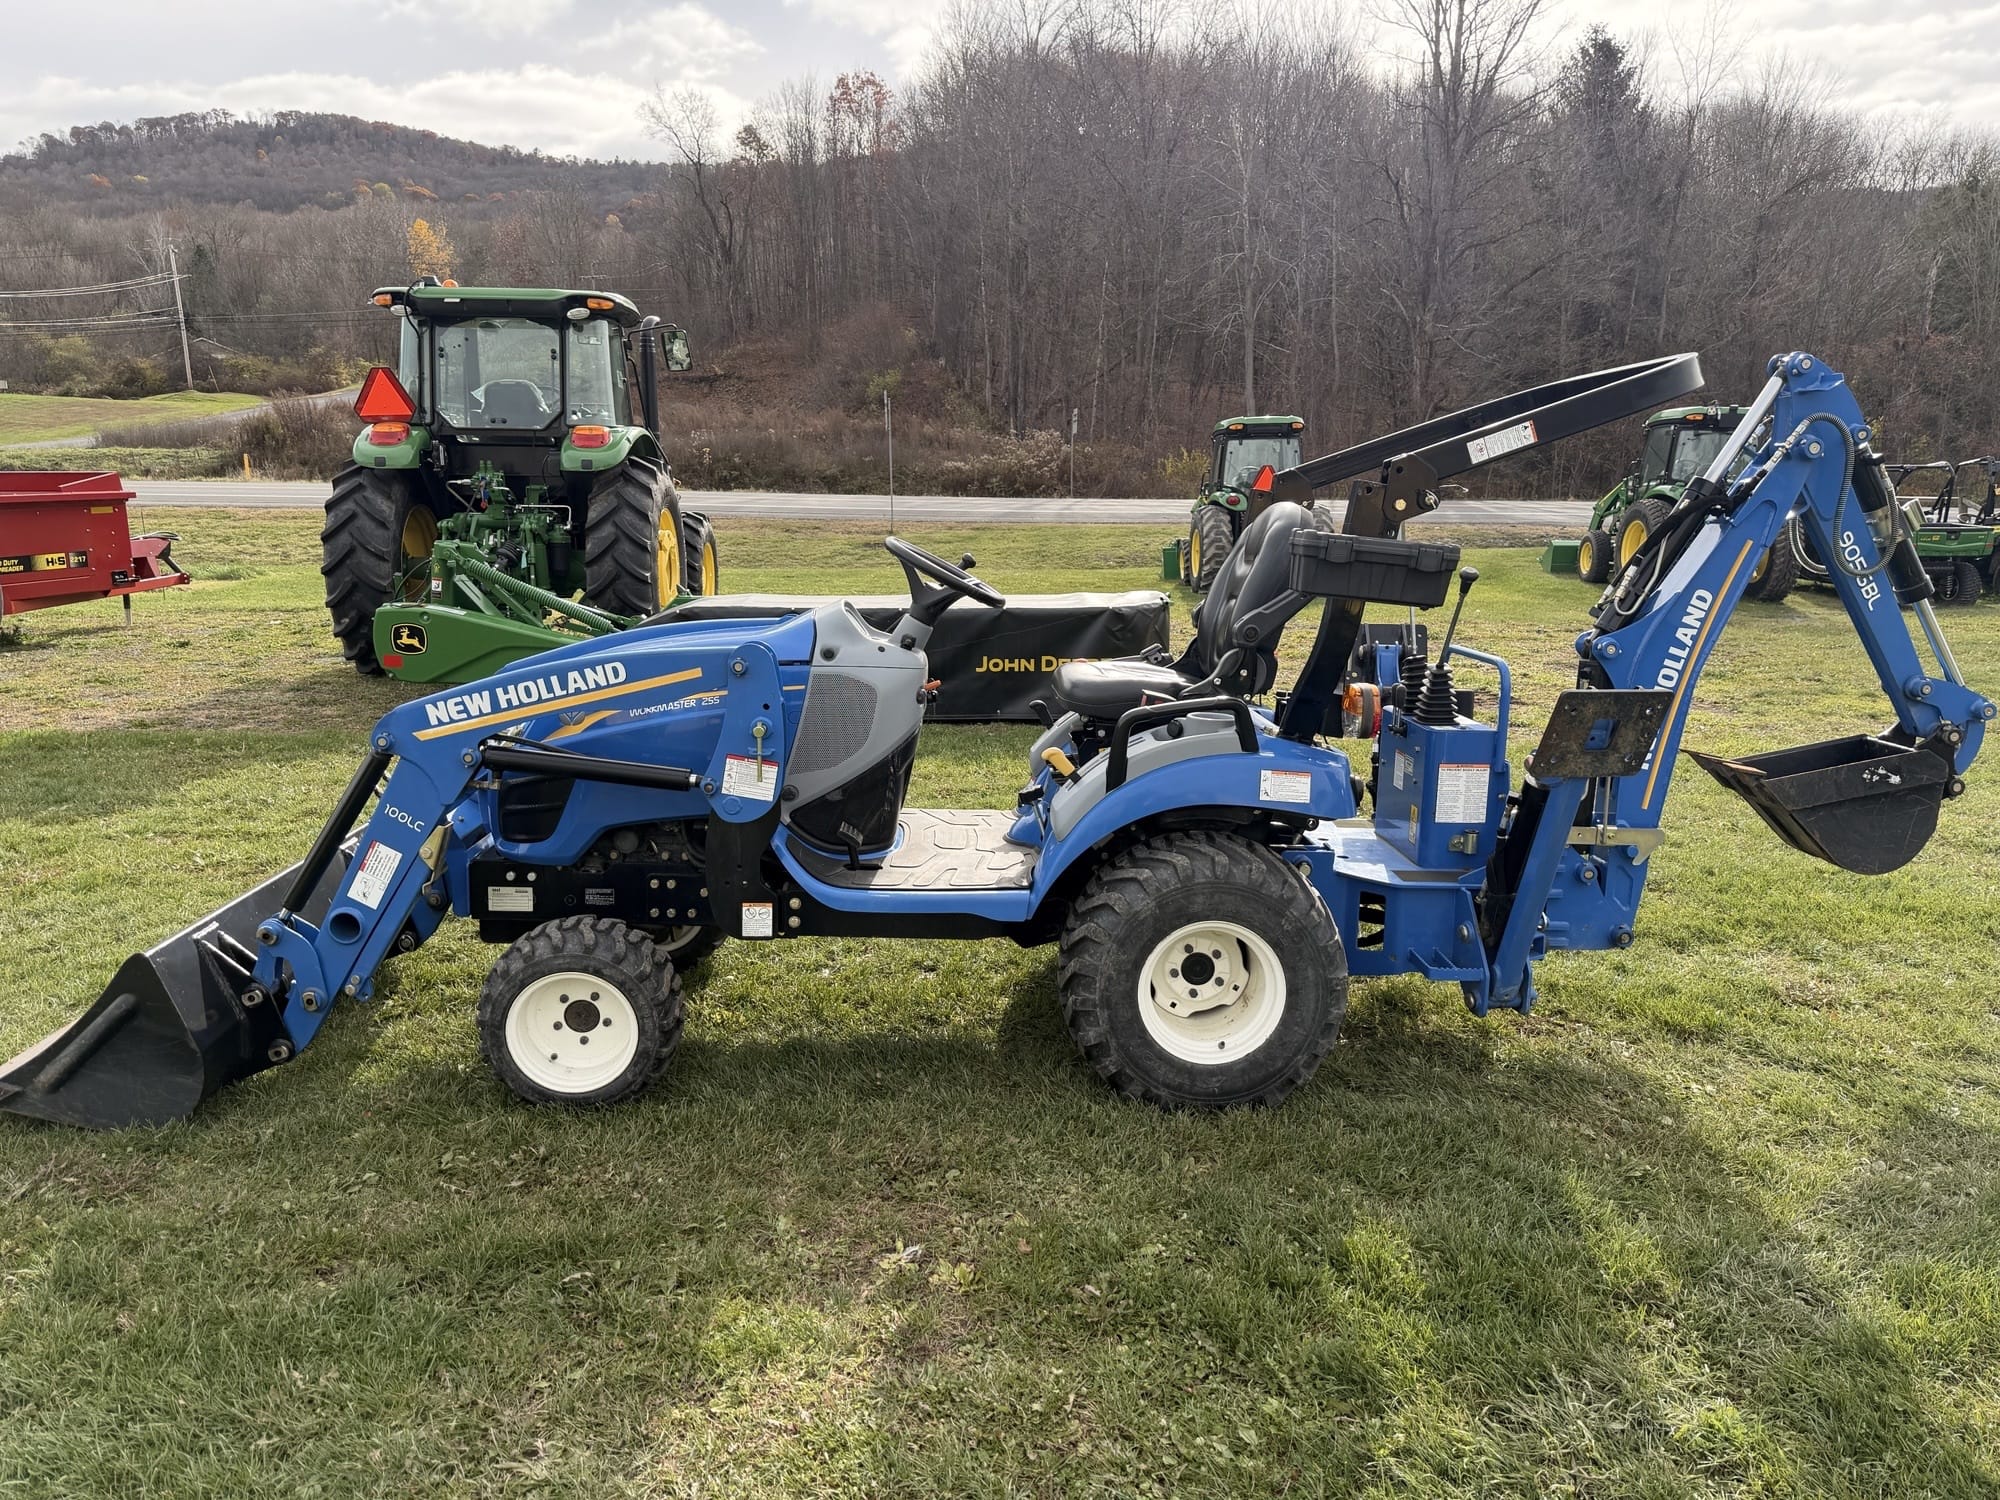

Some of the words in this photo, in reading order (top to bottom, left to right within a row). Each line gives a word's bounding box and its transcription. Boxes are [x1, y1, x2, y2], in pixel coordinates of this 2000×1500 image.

[976, 656, 1035, 673] JOHN
[425, 690, 492, 726] NEW
[495, 661, 627, 709] HOLLAND
[384, 803, 425, 833] 100LC
